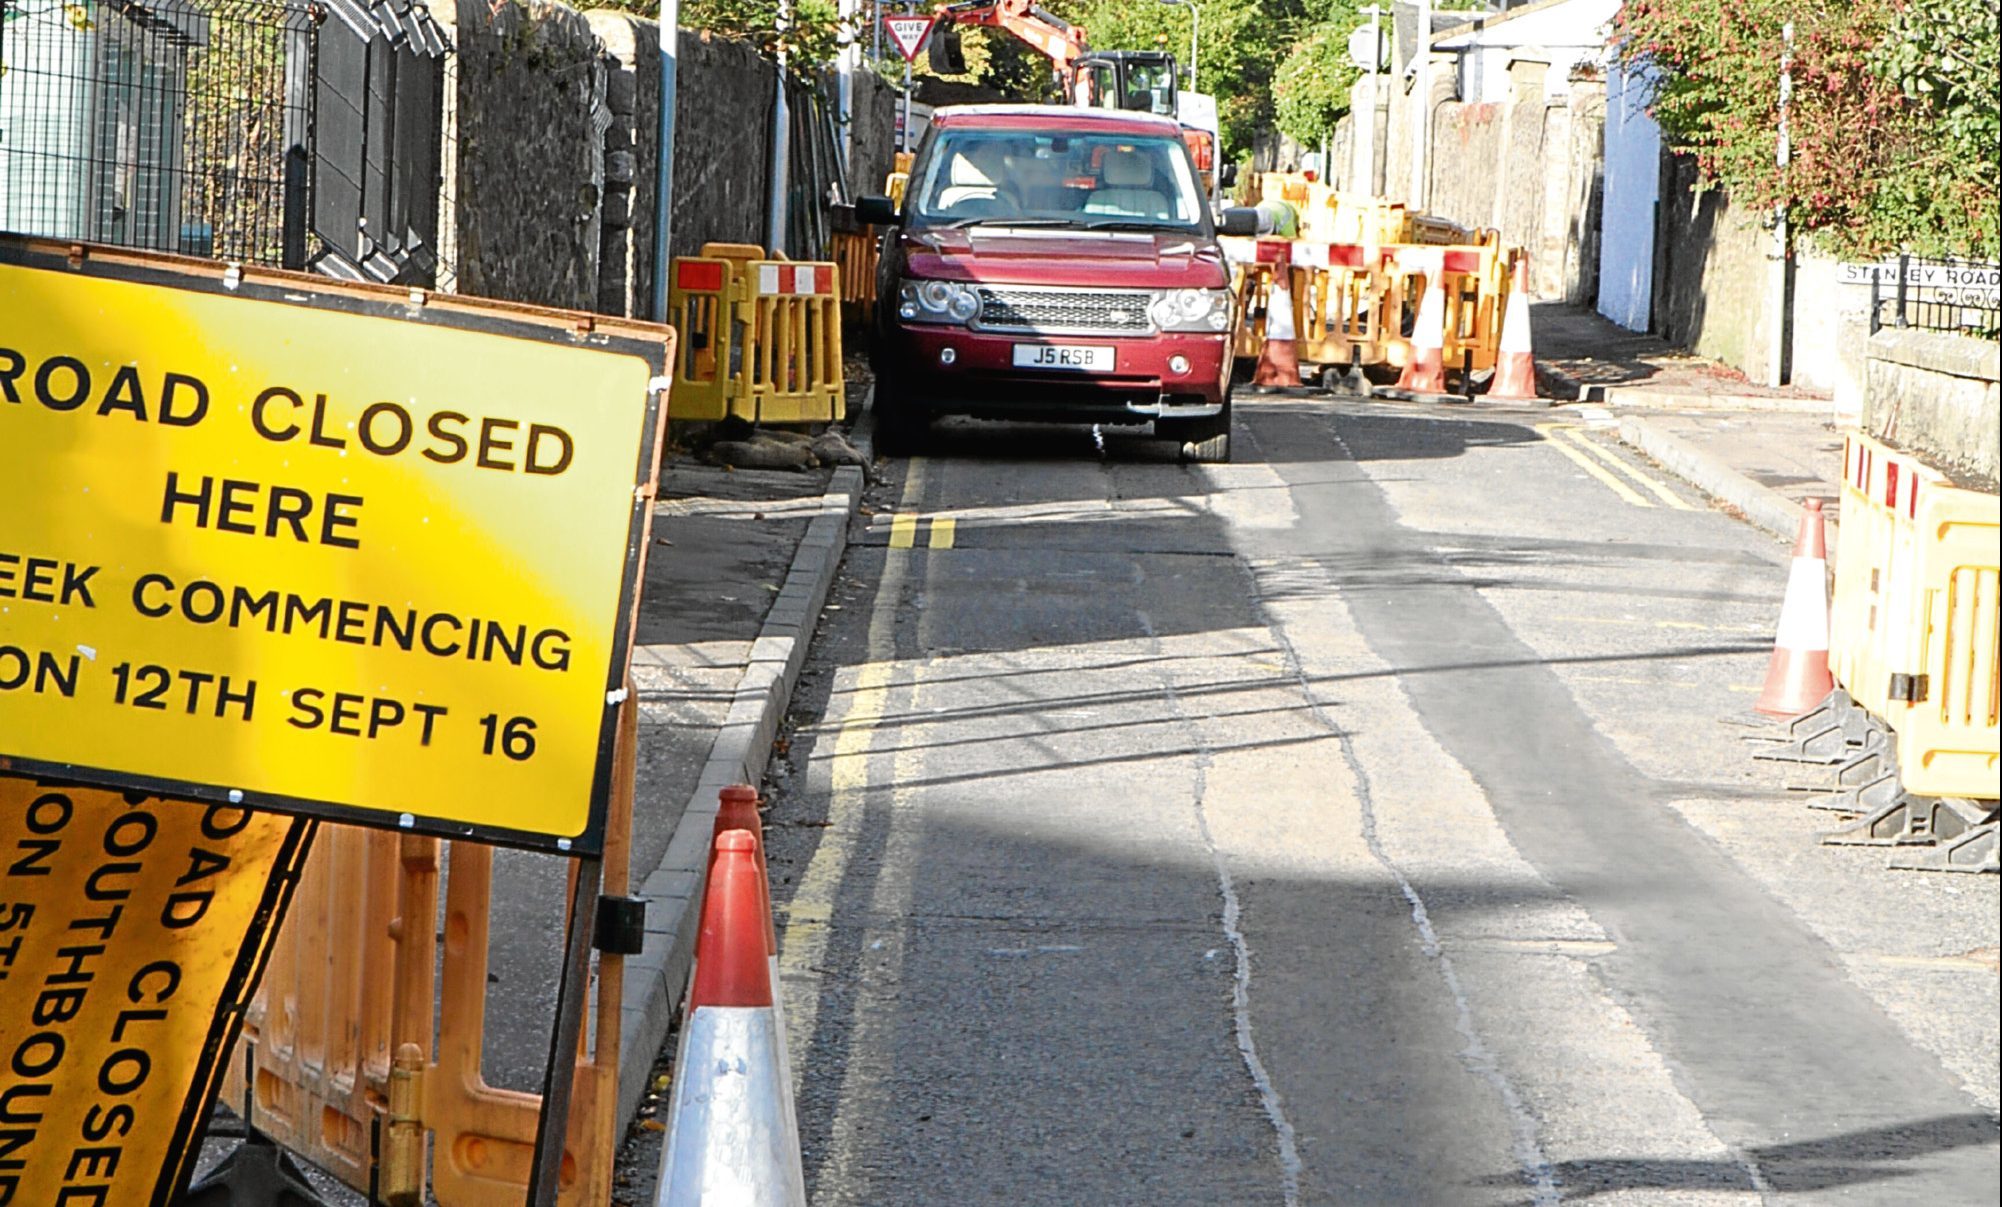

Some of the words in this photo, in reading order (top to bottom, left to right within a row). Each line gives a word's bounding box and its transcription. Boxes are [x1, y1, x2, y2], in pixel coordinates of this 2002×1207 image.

[894, 22, 922, 31] GIVE
[1847, 266, 1935, 282] STNEY
[1946, 269, 2000, 286] ROAD
[1033, 347, 1055, 364] J5
[1060, 348, 1094, 365] RSB
[252, 386, 573, 476] CLOSED
[161, 471, 363, 549] HERE
[132, 573, 571, 672] COMMENCING
[111, 662, 257, 721] 12TH
[286, 687, 447, 747] SEPT
[480, 713, 537, 761] 16
[7, 785, 74, 876] ON
[161, 802, 253, 929] OAD
[0, 903, 36, 980] 5T
[0, 791, 158, 1207] OUTHBOUN
